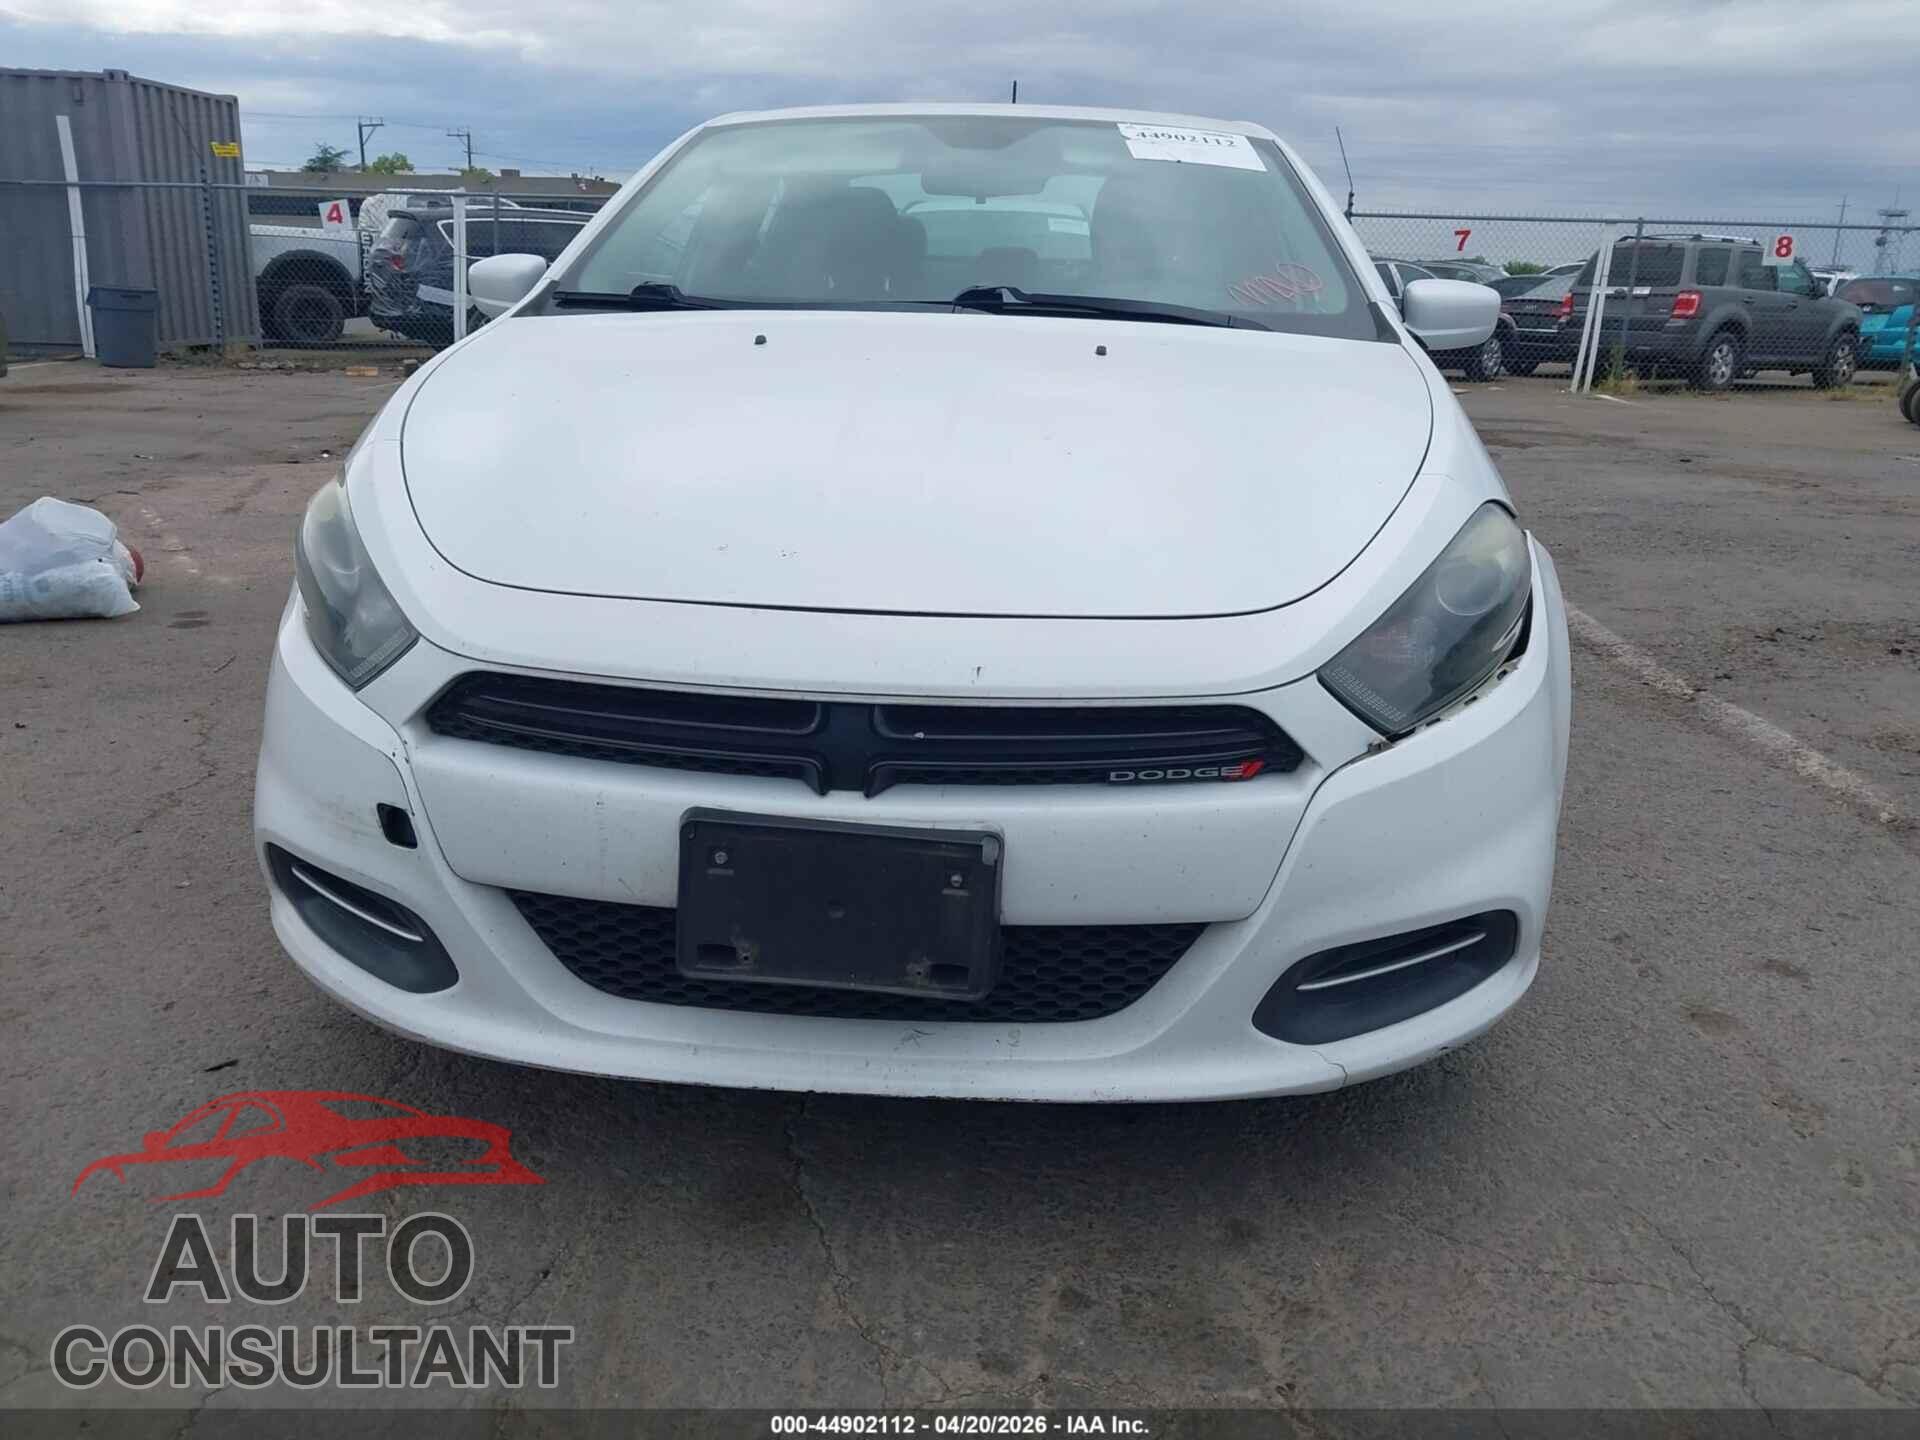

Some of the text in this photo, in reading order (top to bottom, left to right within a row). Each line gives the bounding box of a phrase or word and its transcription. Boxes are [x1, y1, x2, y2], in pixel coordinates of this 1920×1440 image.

[326, 203, 343, 224] 4
[1455, 229, 1471, 251] 7
[1776, 236, 1792, 257] 8
[1109, 765, 1244, 781] DODGE
